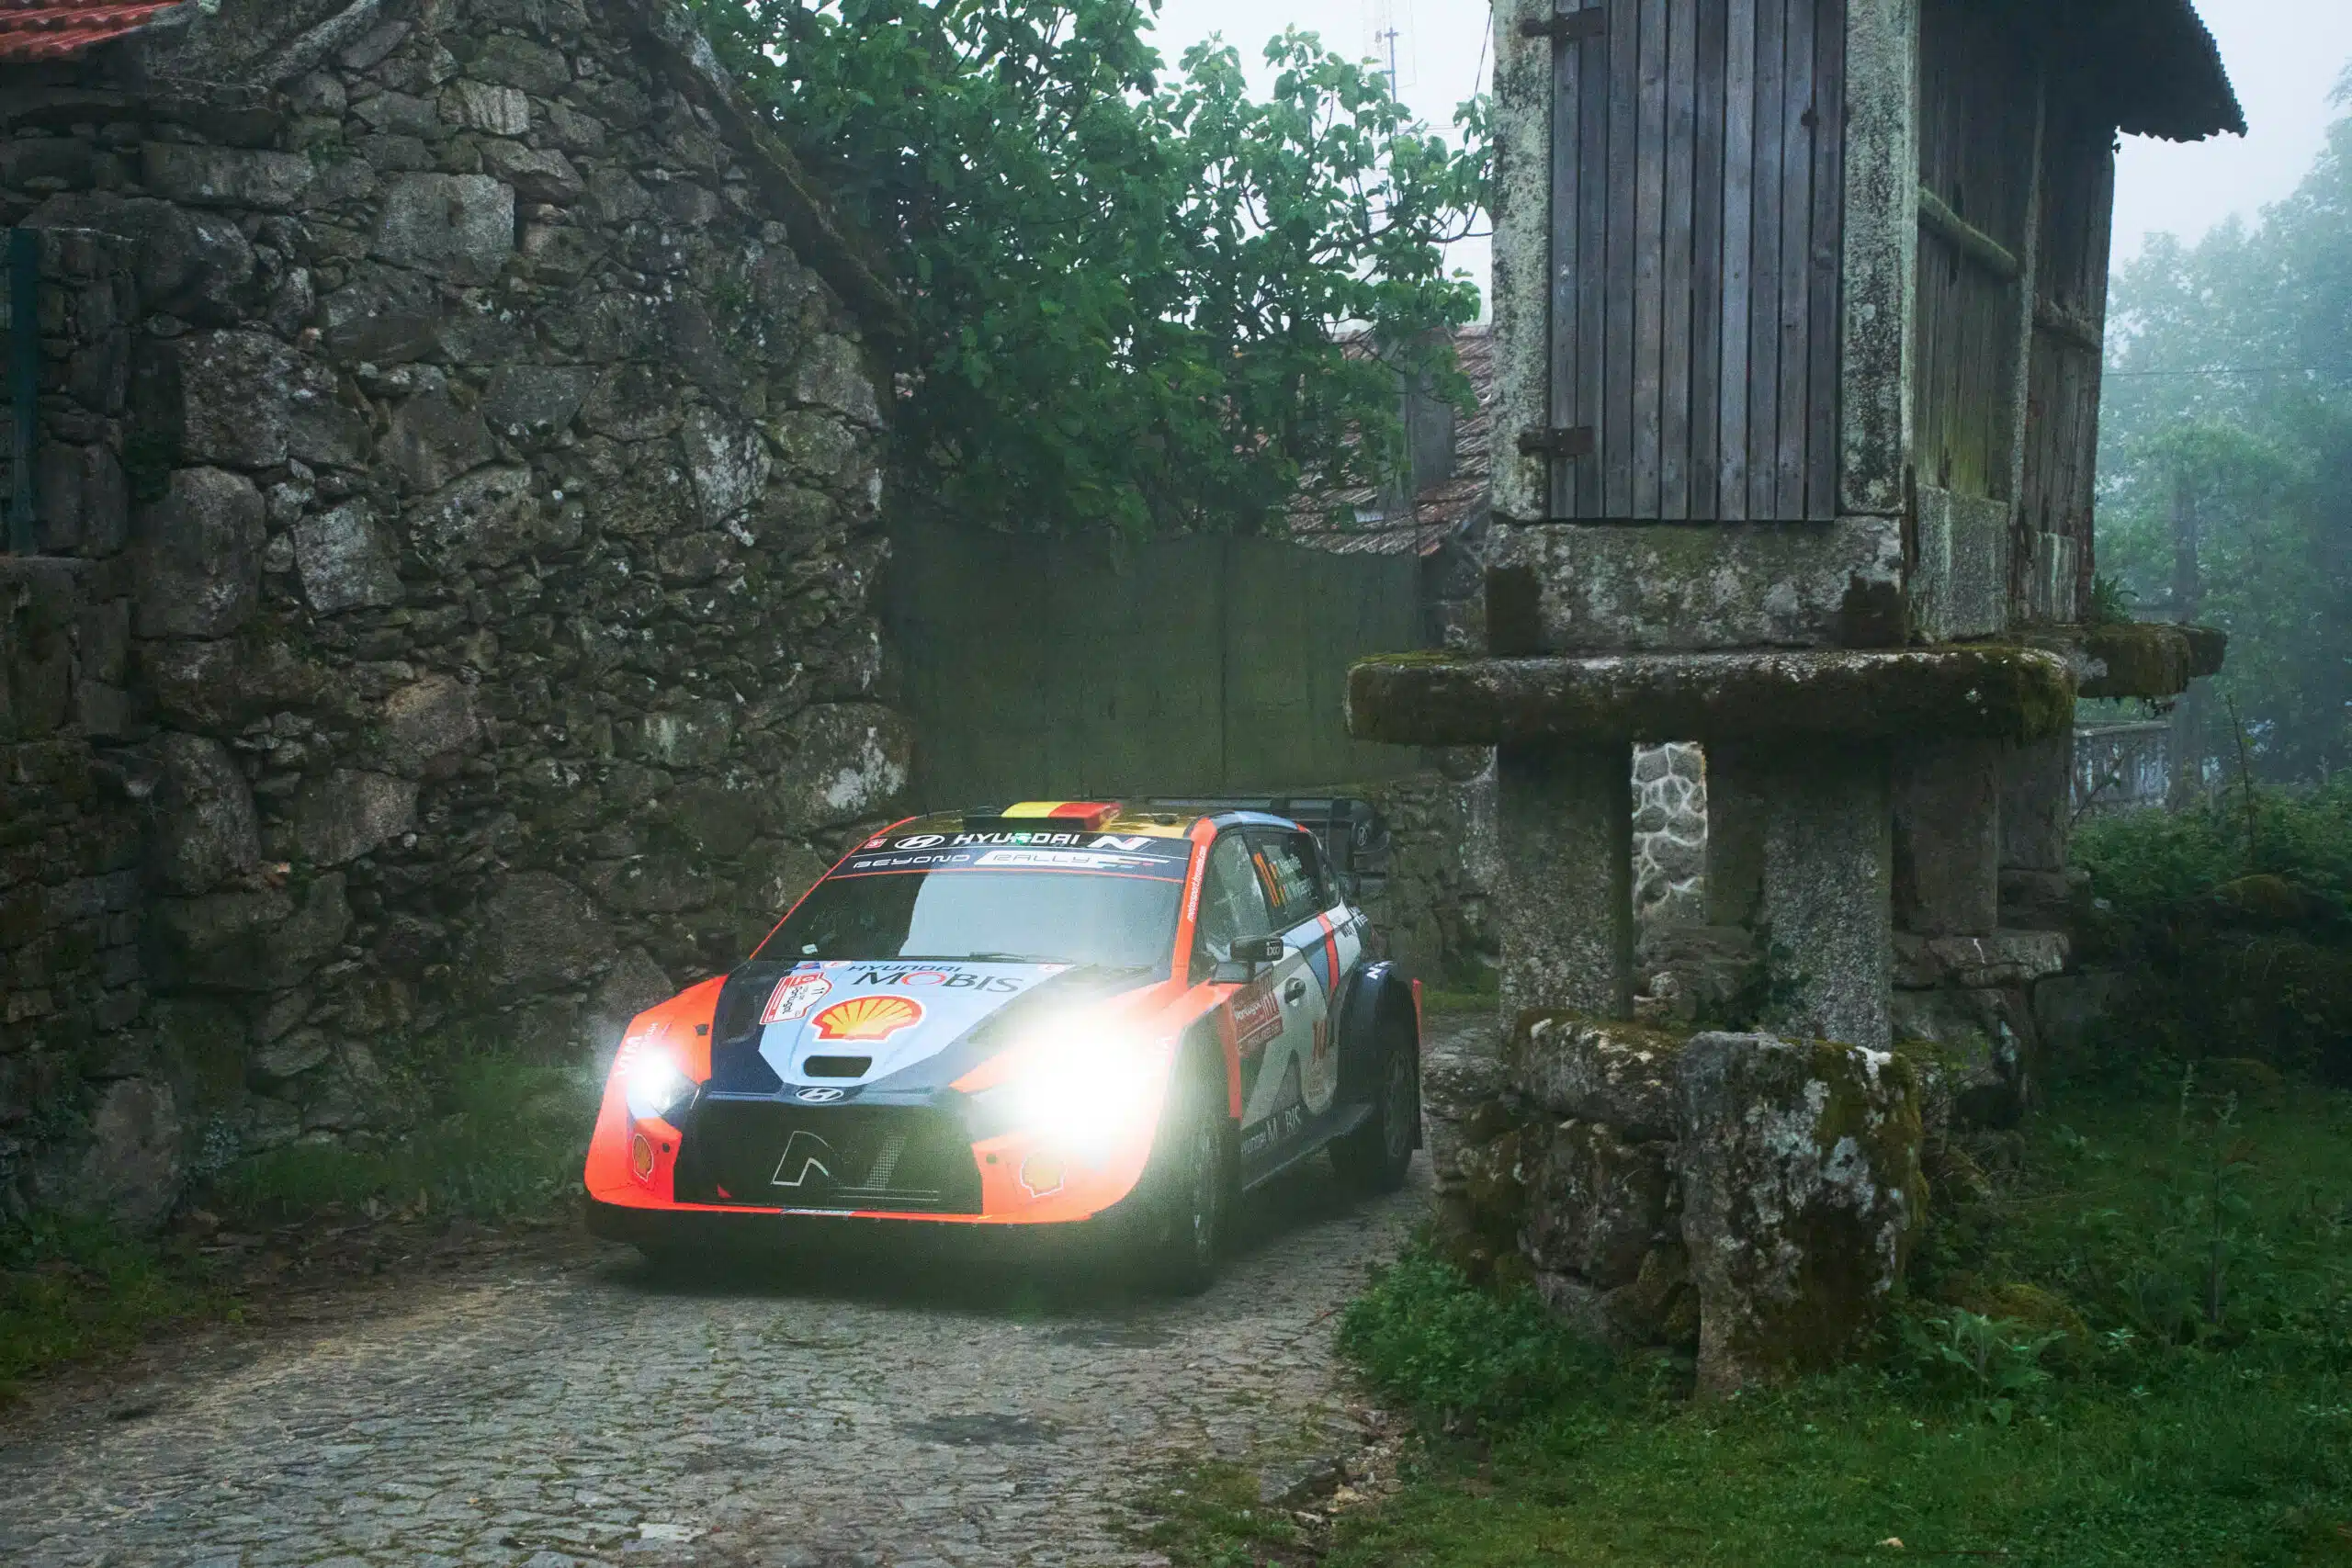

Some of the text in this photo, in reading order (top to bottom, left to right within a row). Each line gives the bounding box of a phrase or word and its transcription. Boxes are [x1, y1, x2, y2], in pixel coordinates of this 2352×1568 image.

[953, 832, 1081, 845] HYUNDAI
[853, 853, 1091, 868] BEYOND RALLY
[851, 971, 1023, 993] MOBIS
